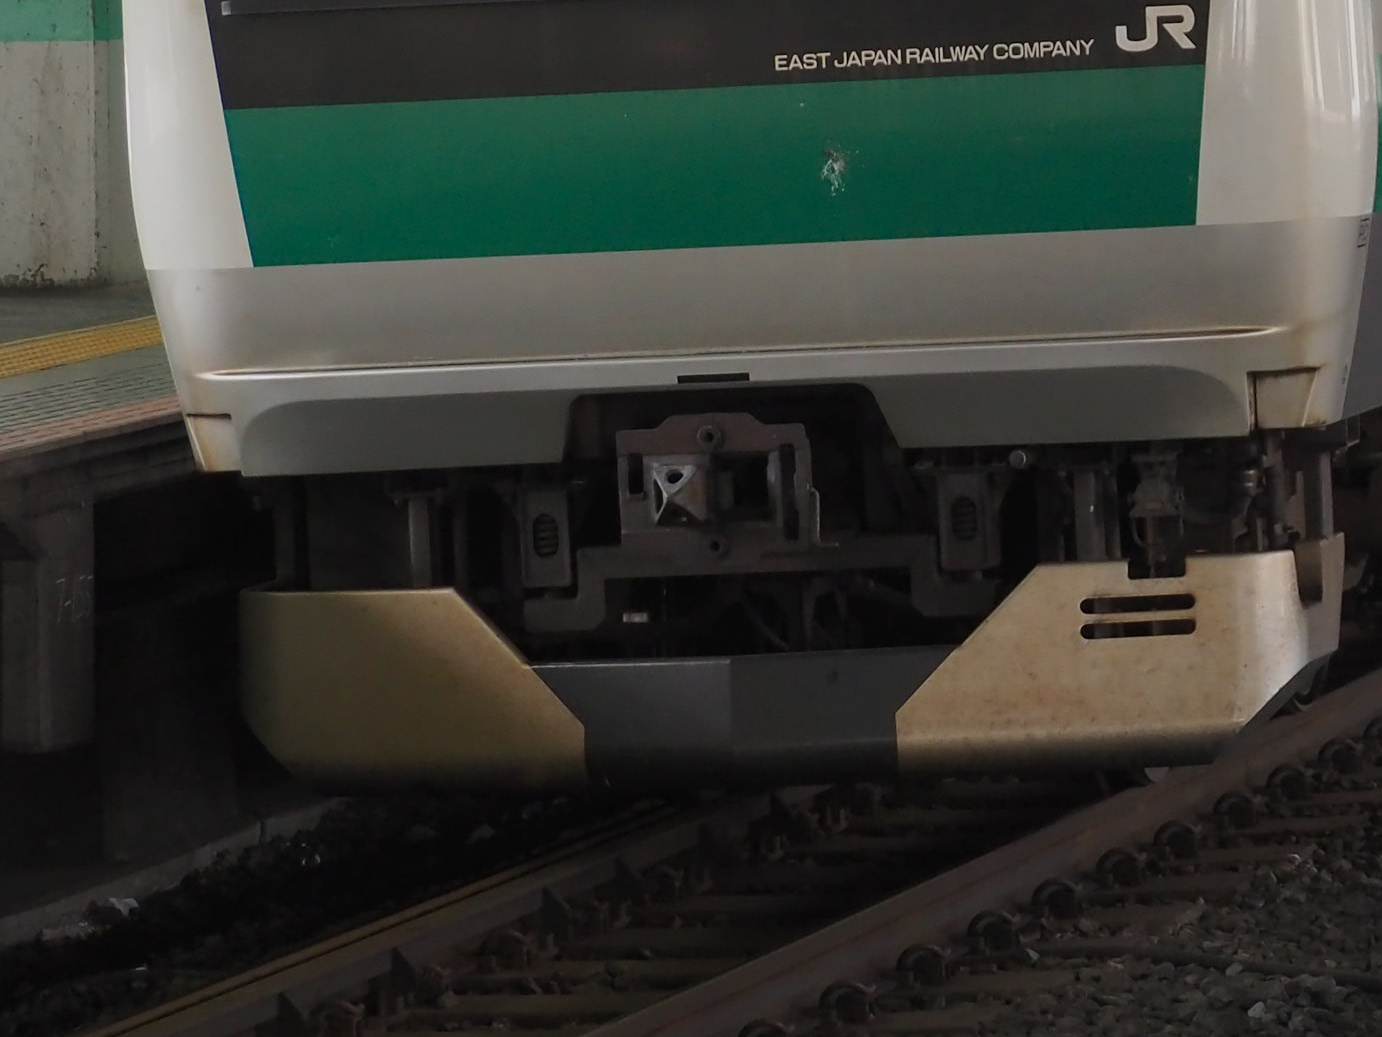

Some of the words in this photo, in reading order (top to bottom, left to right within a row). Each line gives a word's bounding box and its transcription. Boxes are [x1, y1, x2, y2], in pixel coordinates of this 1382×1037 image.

[1114, 4, 1197, 53] JR
[774, 52, 831, 72] EAST
[834, 48, 902, 68] JAPAN
[905, 44, 990, 65] RAILWAY
[992, 39, 1096, 60] COMPANY
